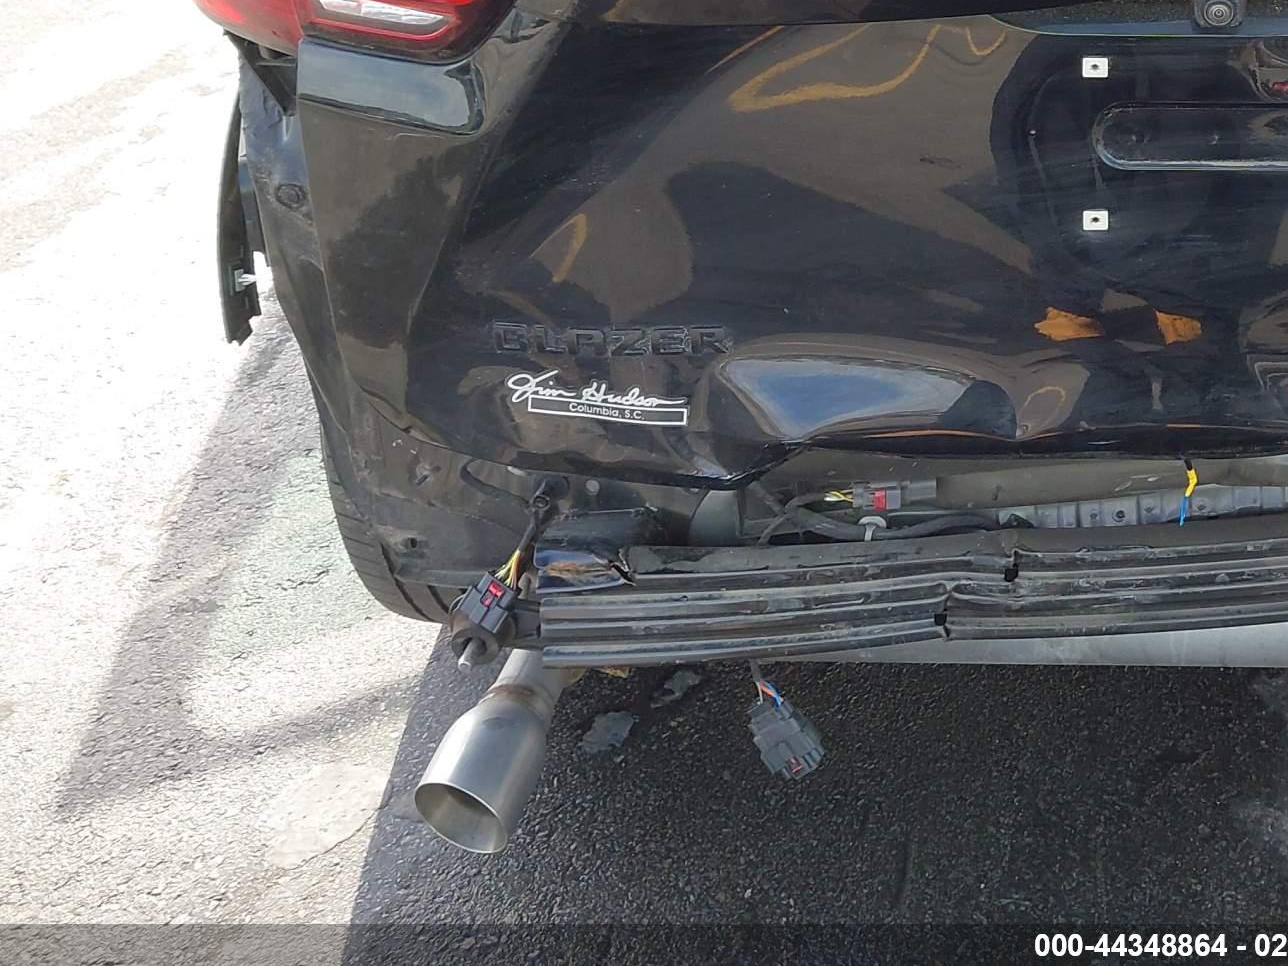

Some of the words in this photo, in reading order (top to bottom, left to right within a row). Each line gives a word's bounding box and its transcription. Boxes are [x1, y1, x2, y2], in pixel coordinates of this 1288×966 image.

[493, 320, 731, 356] BLAZER
[507, 370, 576, 403] Jim
[581, 382, 686, 406] Hudson
[569, 402, 622, 418] Columbia,
[624, 408, 645, 421] S.C.
